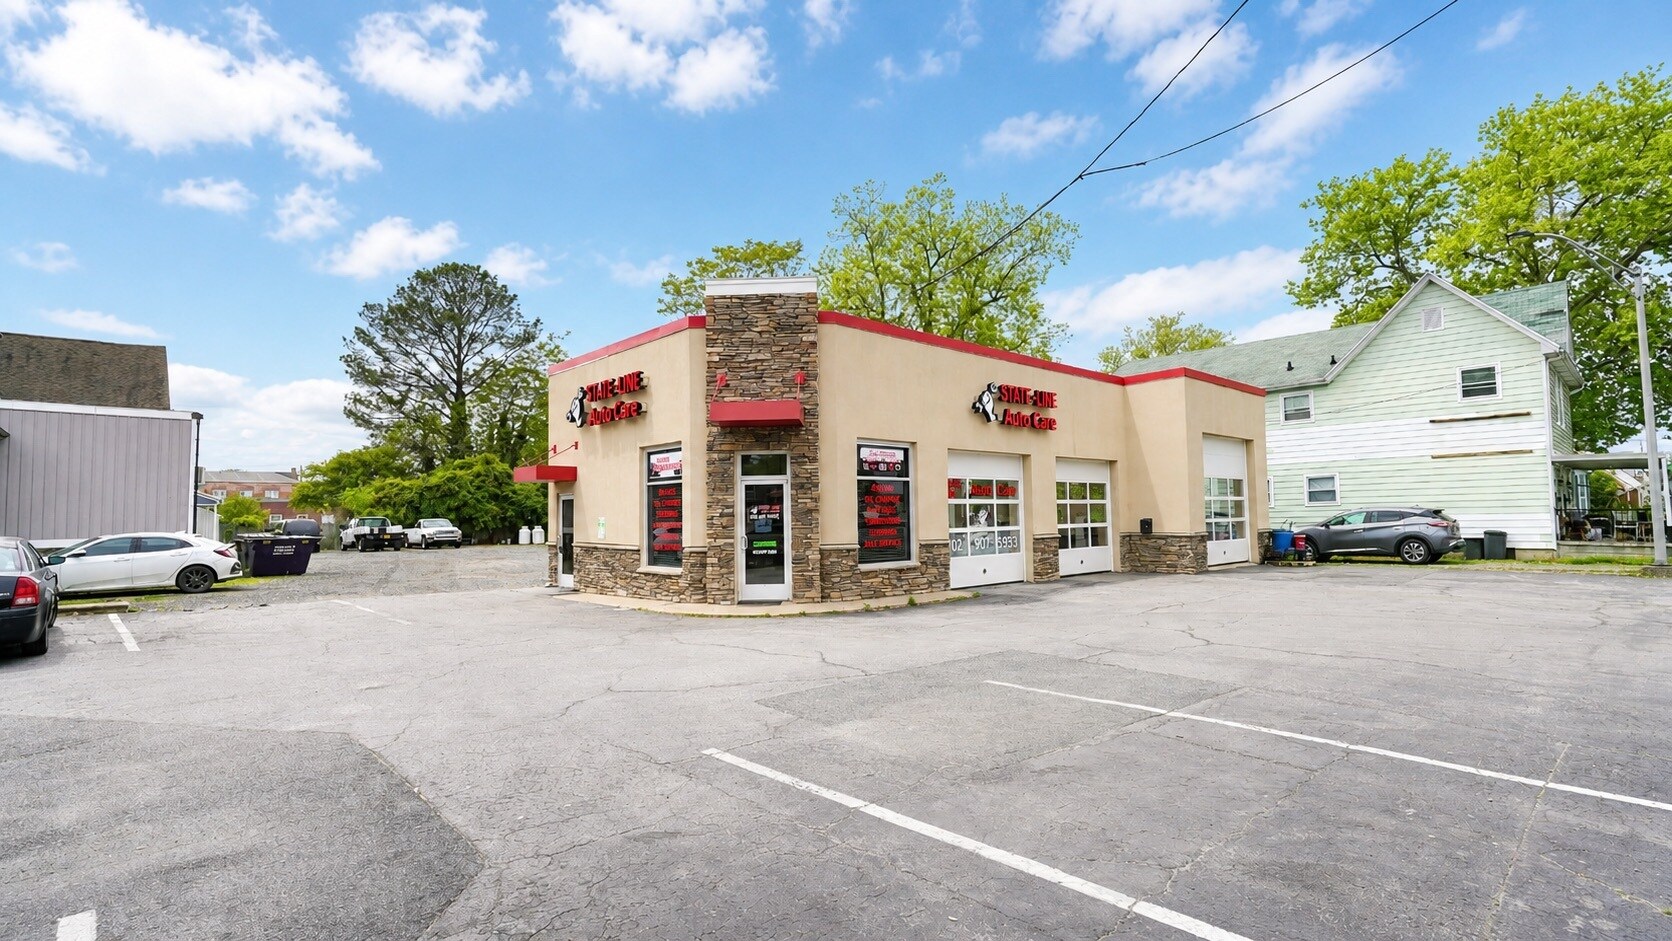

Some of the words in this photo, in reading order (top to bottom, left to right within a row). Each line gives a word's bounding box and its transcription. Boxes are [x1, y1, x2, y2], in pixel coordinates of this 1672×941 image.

[586, 370, 645, 403] STATE-LINE
[998, 383, 1057, 409] STATE-LINE
[587, 405, 614, 426] Auto
[613, 400, 645, 421] Care
[1002, 408, 1030, 428] Auto
[1030, 411, 1057, 431] Care
[974, 536, 990, 550] 907
